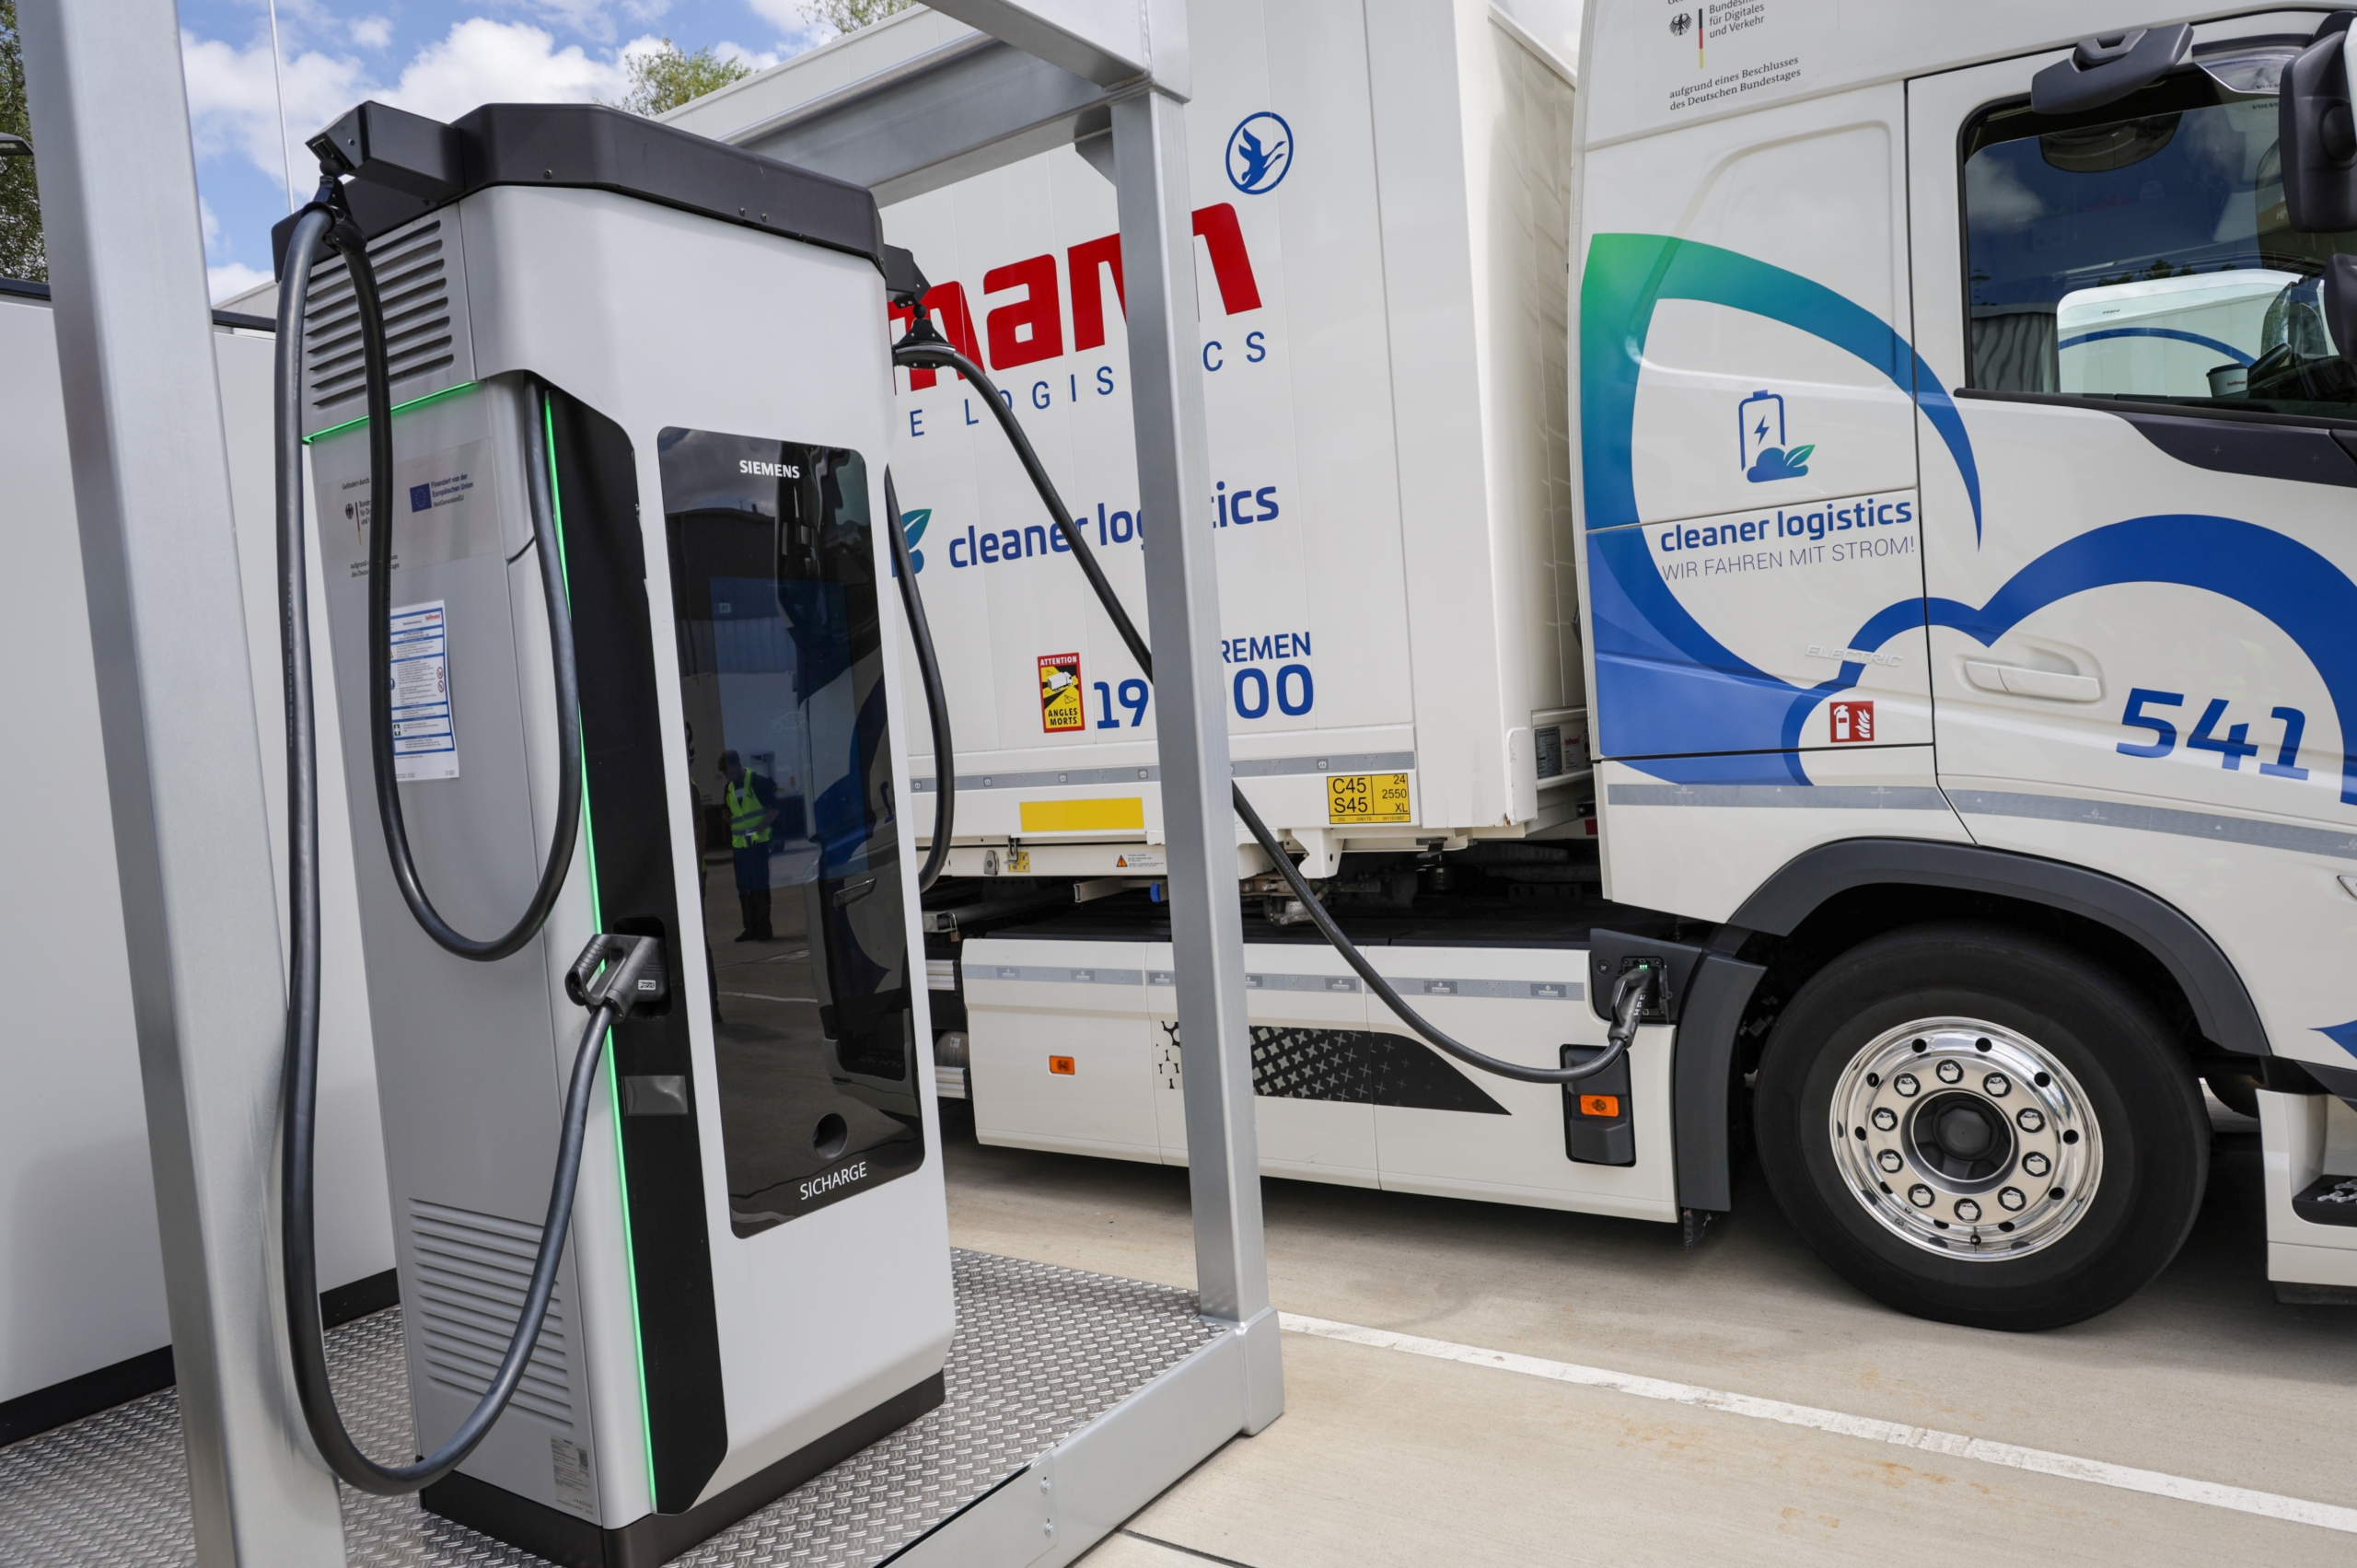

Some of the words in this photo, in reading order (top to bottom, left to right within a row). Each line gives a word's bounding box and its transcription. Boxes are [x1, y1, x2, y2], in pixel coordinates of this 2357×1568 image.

[1709, 16, 1722, 26] für
[1724, 4, 1765, 21] Digitales
[1709, 25, 1726, 38] und
[1729, 15, 1765, 31] Verkehr
[1669, 79, 1713, 99] aufgrund
[1714, 73, 1739, 87] eines
[1741, 57, 1799, 78] Beschlusses
[1669, 101, 1686, 110] des
[1688, 86, 1737, 106] Deutschen
[1739, 69, 1801, 92] Bundestages
[739, 459, 800, 479] SIEMENS
[431, 478, 451, 488] Finanziert
[432, 485, 459, 498] Europäischen
[460, 482, 473, 490] Union
[1660, 519, 1770, 552] cleaner
[1777, 498, 1912, 541] logistics
[1662, 561, 1699, 581] WIR
[1704, 551, 1783, 575] FAHREN
[1789, 545, 1826, 566] MIT
[1832, 536, 1915, 562] STROM!
[1040, 655, 1077, 666] ATTENTION
[1805, 645, 1902, 668] ELECTRIC
[1048, 707, 1078, 717] ANGLES
[1050, 716, 1077, 726] MORTS
[2116, 687, 2309, 781] 541
[1332, 777, 1367, 794] C45
[1393, 774, 1406, 784] 24
[1382, 788, 1407, 799] 2550
[1334, 796, 1368, 813] S45
[1395, 802, 1409, 812] XL
[799, 1161, 867, 1201] SICHARGE
